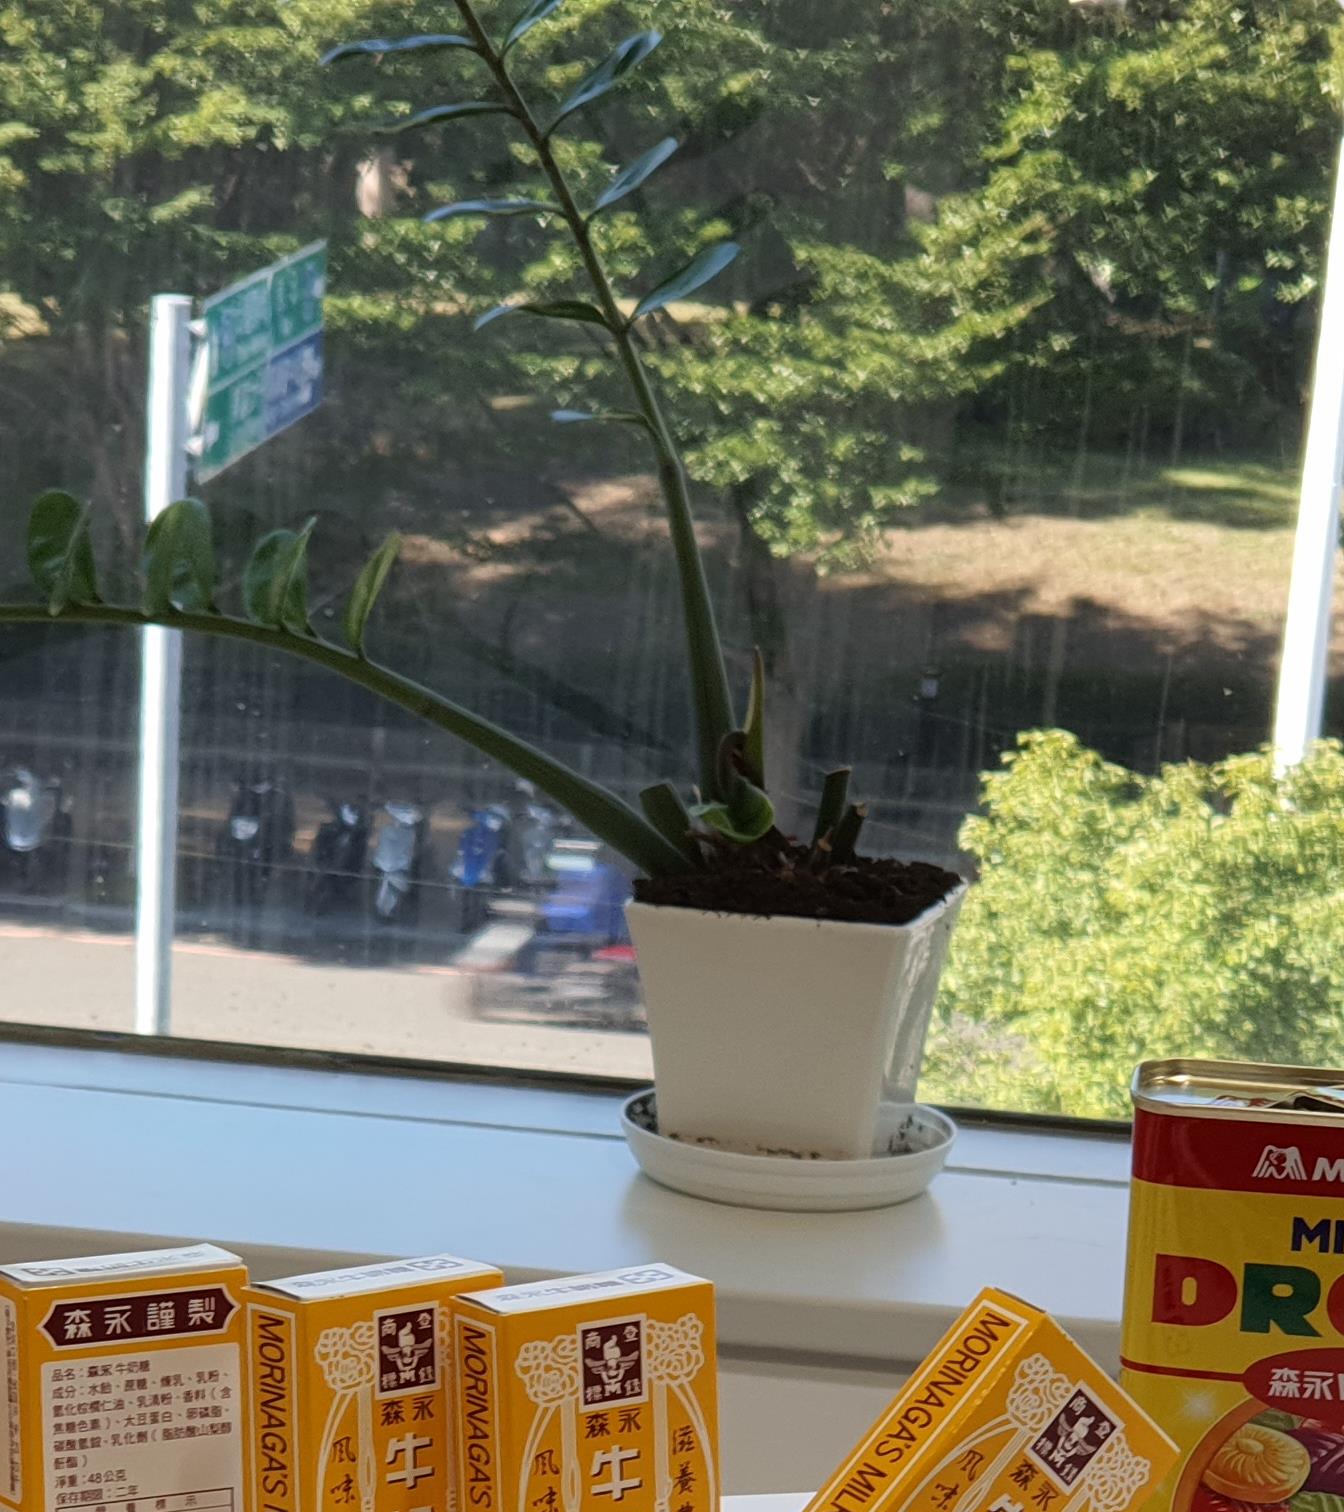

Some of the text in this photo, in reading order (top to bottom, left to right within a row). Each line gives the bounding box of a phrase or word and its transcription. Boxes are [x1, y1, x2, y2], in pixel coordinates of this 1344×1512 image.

[64, 1297, 216, 1340] 森永謹製
[258, 1314, 288, 1498] MORINAGA'S
[381, 1395, 435, 1426] 森永
[875, 1312, 1010, 1464] MORINAGA'S
[462, 1326, 492, 1508] MORINAGA'S
[585, 1407, 642, 1439] 森永
[1008, 1458, 1060, 1512] 森永
